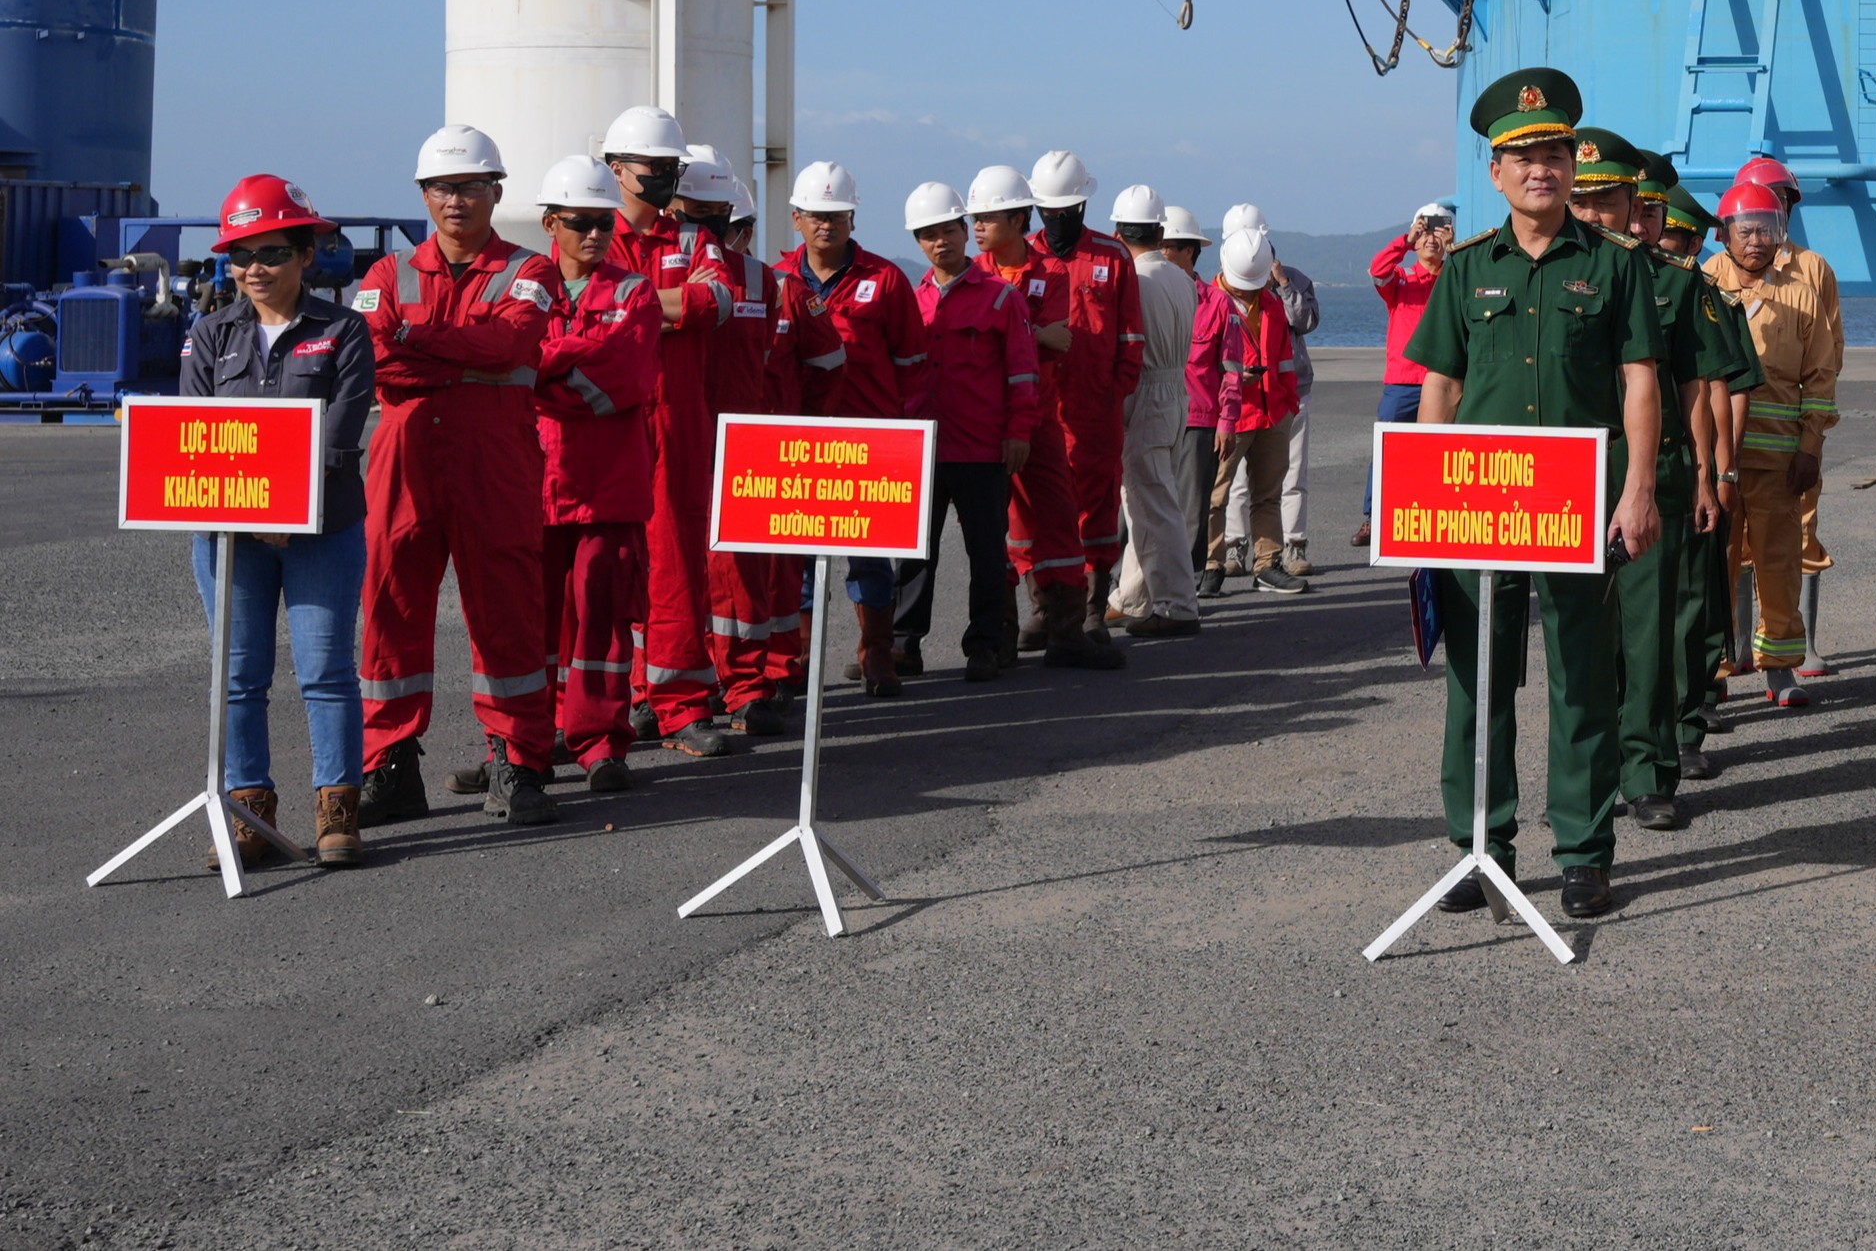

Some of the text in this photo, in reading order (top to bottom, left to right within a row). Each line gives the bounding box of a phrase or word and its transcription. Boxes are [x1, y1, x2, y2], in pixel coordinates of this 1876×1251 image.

[180, 419, 258, 461] LỰC LƯỢNG
[779, 439, 869, 468] LỰC LƯỢNG
[164, 470, 270, 509] KHÁCH HÀNG
[732, 469, 913, 503] CẢNH SÁT GIAO THÔNG
[1443, 448, 1534, 494] LỰC LƯỢNG
[769, 509, 872, 539] ĐƯỜNG THỦY
[1392, 499, 1582, 549] BIÊN PHÒNG CỬA KHẨU
